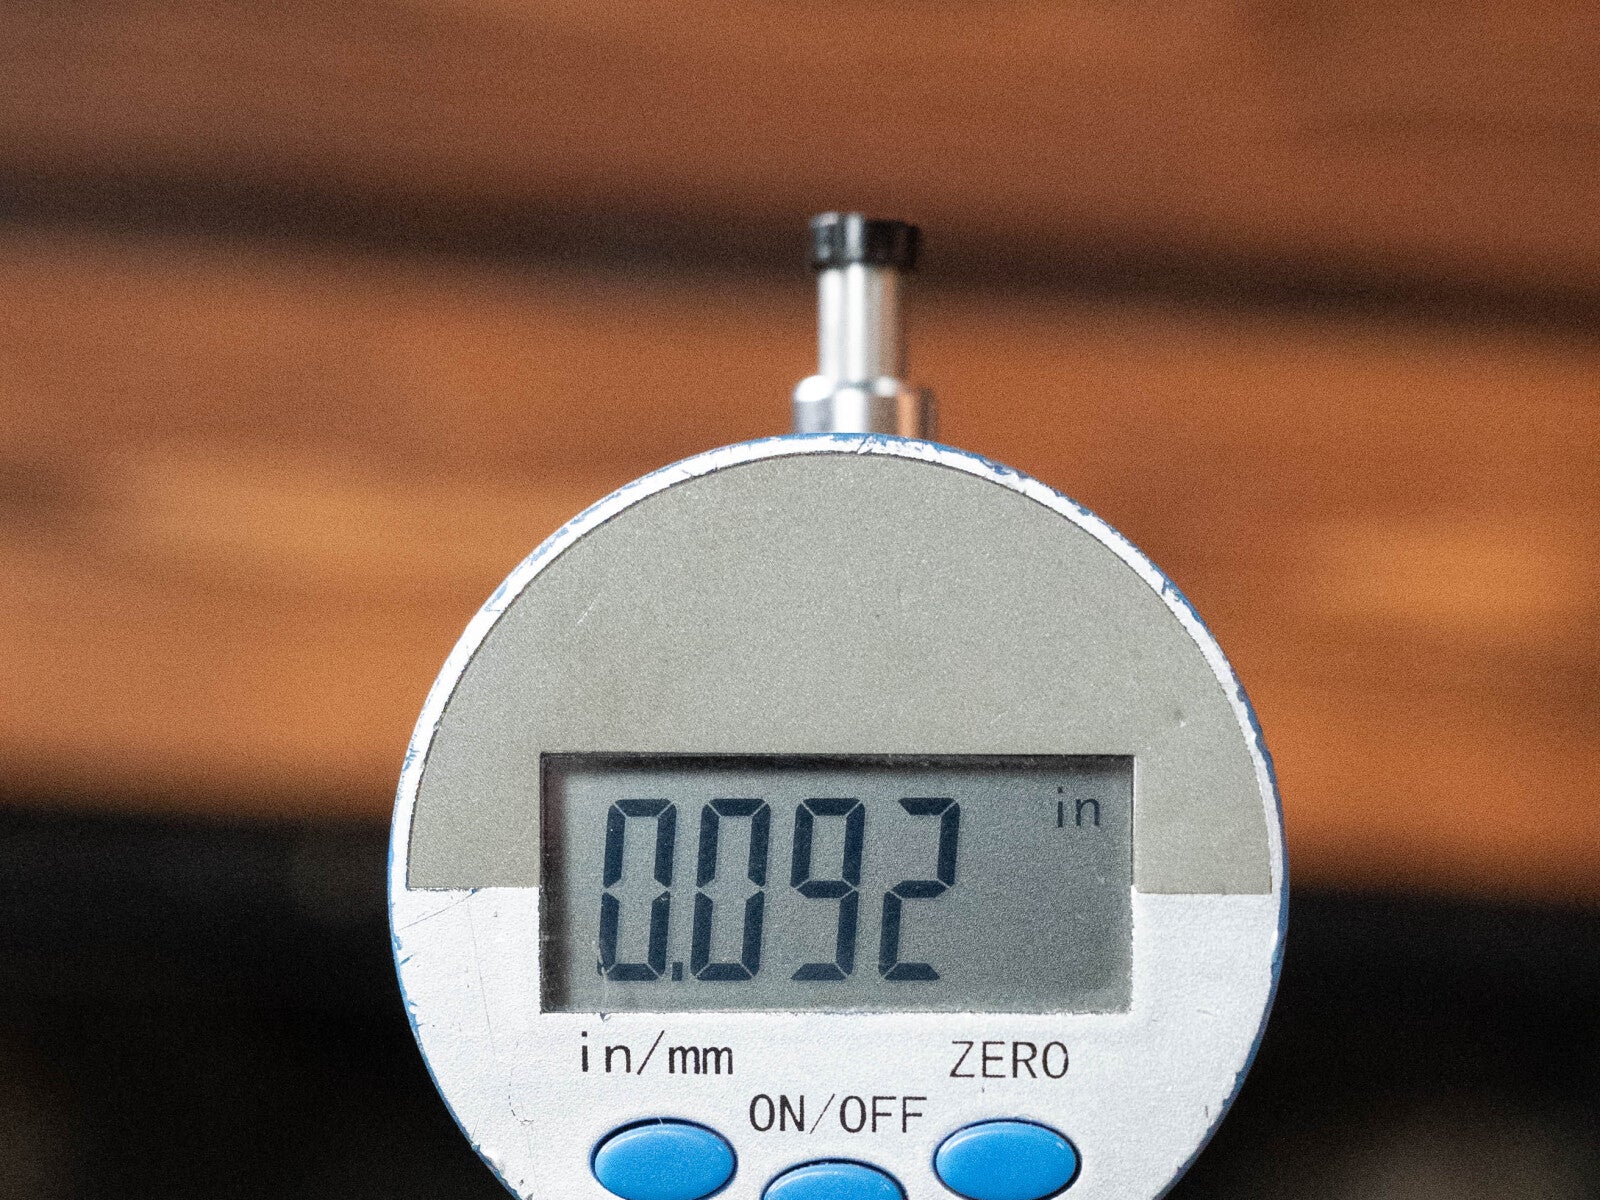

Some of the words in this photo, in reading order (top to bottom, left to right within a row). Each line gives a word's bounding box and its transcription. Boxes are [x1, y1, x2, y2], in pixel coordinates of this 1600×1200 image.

[599, 797, 961, 981] 0.092
[1056, 786, 1101, 828] in
[580, 1030, 734, 1076] in/mm
[949, 1040, 1070, 1079] ZERO
[748, 1093, 928, 1134] ON/OFF
